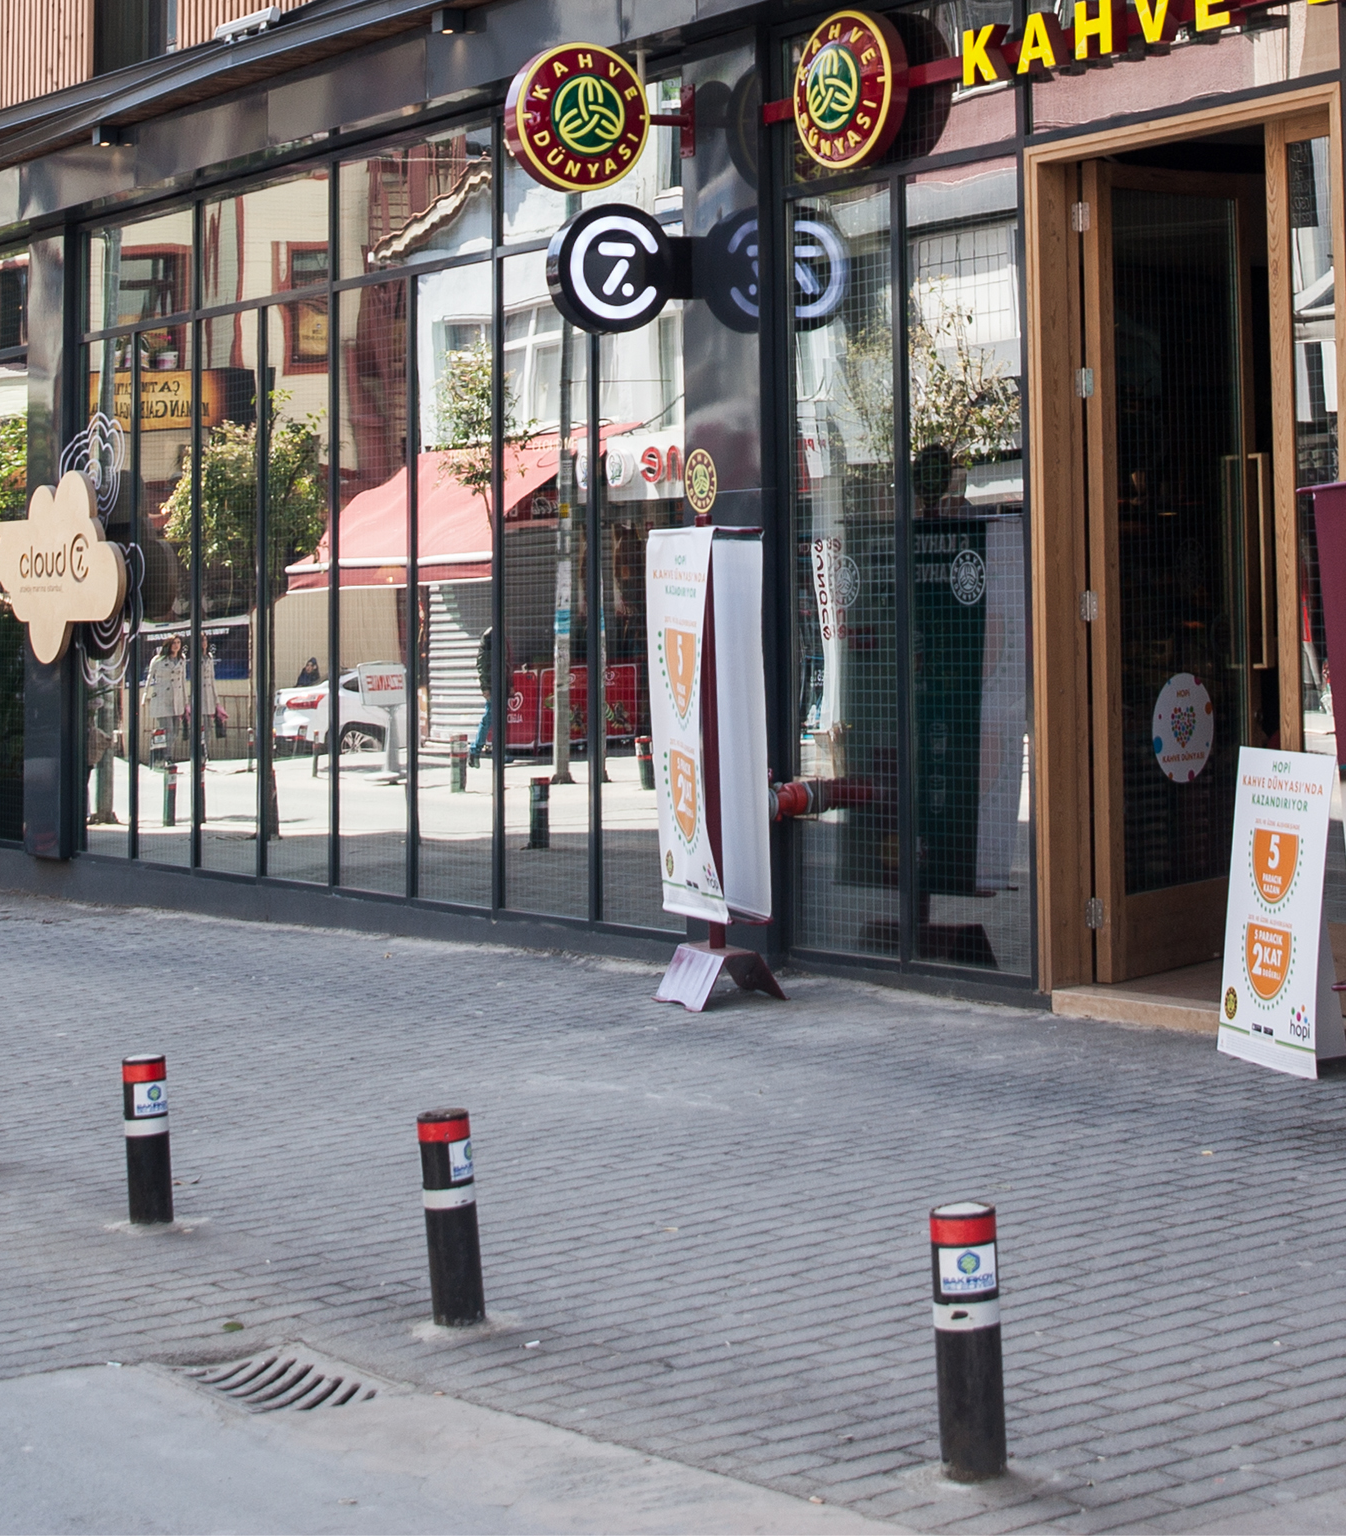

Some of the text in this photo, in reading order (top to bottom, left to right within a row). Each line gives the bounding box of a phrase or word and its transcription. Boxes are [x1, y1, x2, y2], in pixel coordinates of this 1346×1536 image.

[532, 53, 639, 103] KAHVE
[534, 129, 639, 181] DÜNYASI
[19, 543, 67, 579] cloud
[1242, 774, 1266, 789] KAHVE
[1272, 760, 1292, 774] HOPİ
[1251, 793, 1308, 812] KAZANDIRIYOR
[1267, 834, 1281, 870] 5
[1252, 943, 1283, 976] 2 KAT
[1290, 1019, 1311, 1042] hopi
